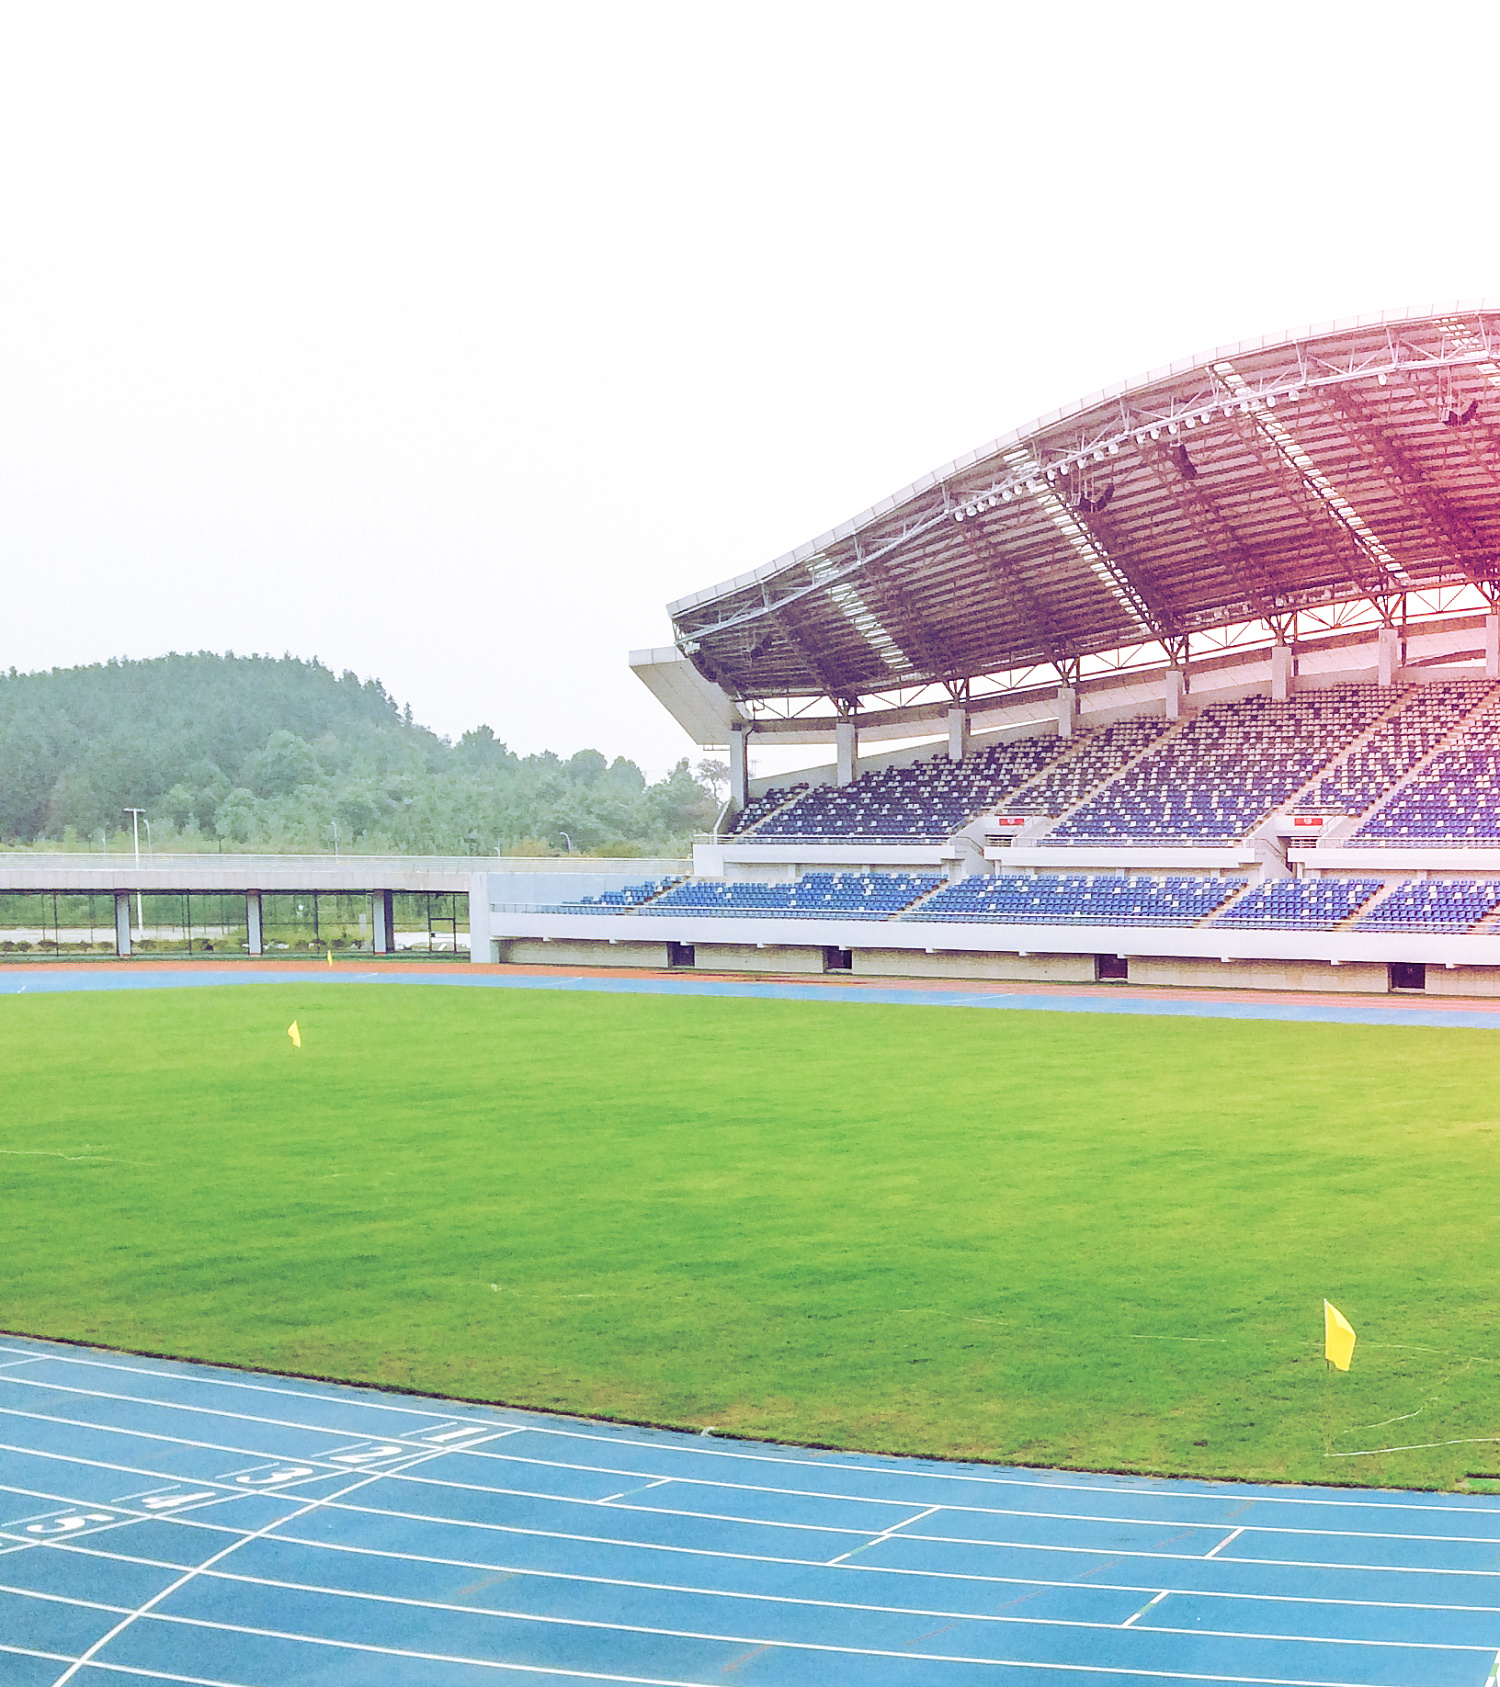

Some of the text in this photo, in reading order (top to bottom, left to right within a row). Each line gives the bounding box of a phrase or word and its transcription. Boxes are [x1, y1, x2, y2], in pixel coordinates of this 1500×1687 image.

[421, 1427, 488, 1443] 1
[329, 1446, 402, 1464] 2
[235, 1467, 313, 1484] 3
[26, 1514, 115, 1534] 5
